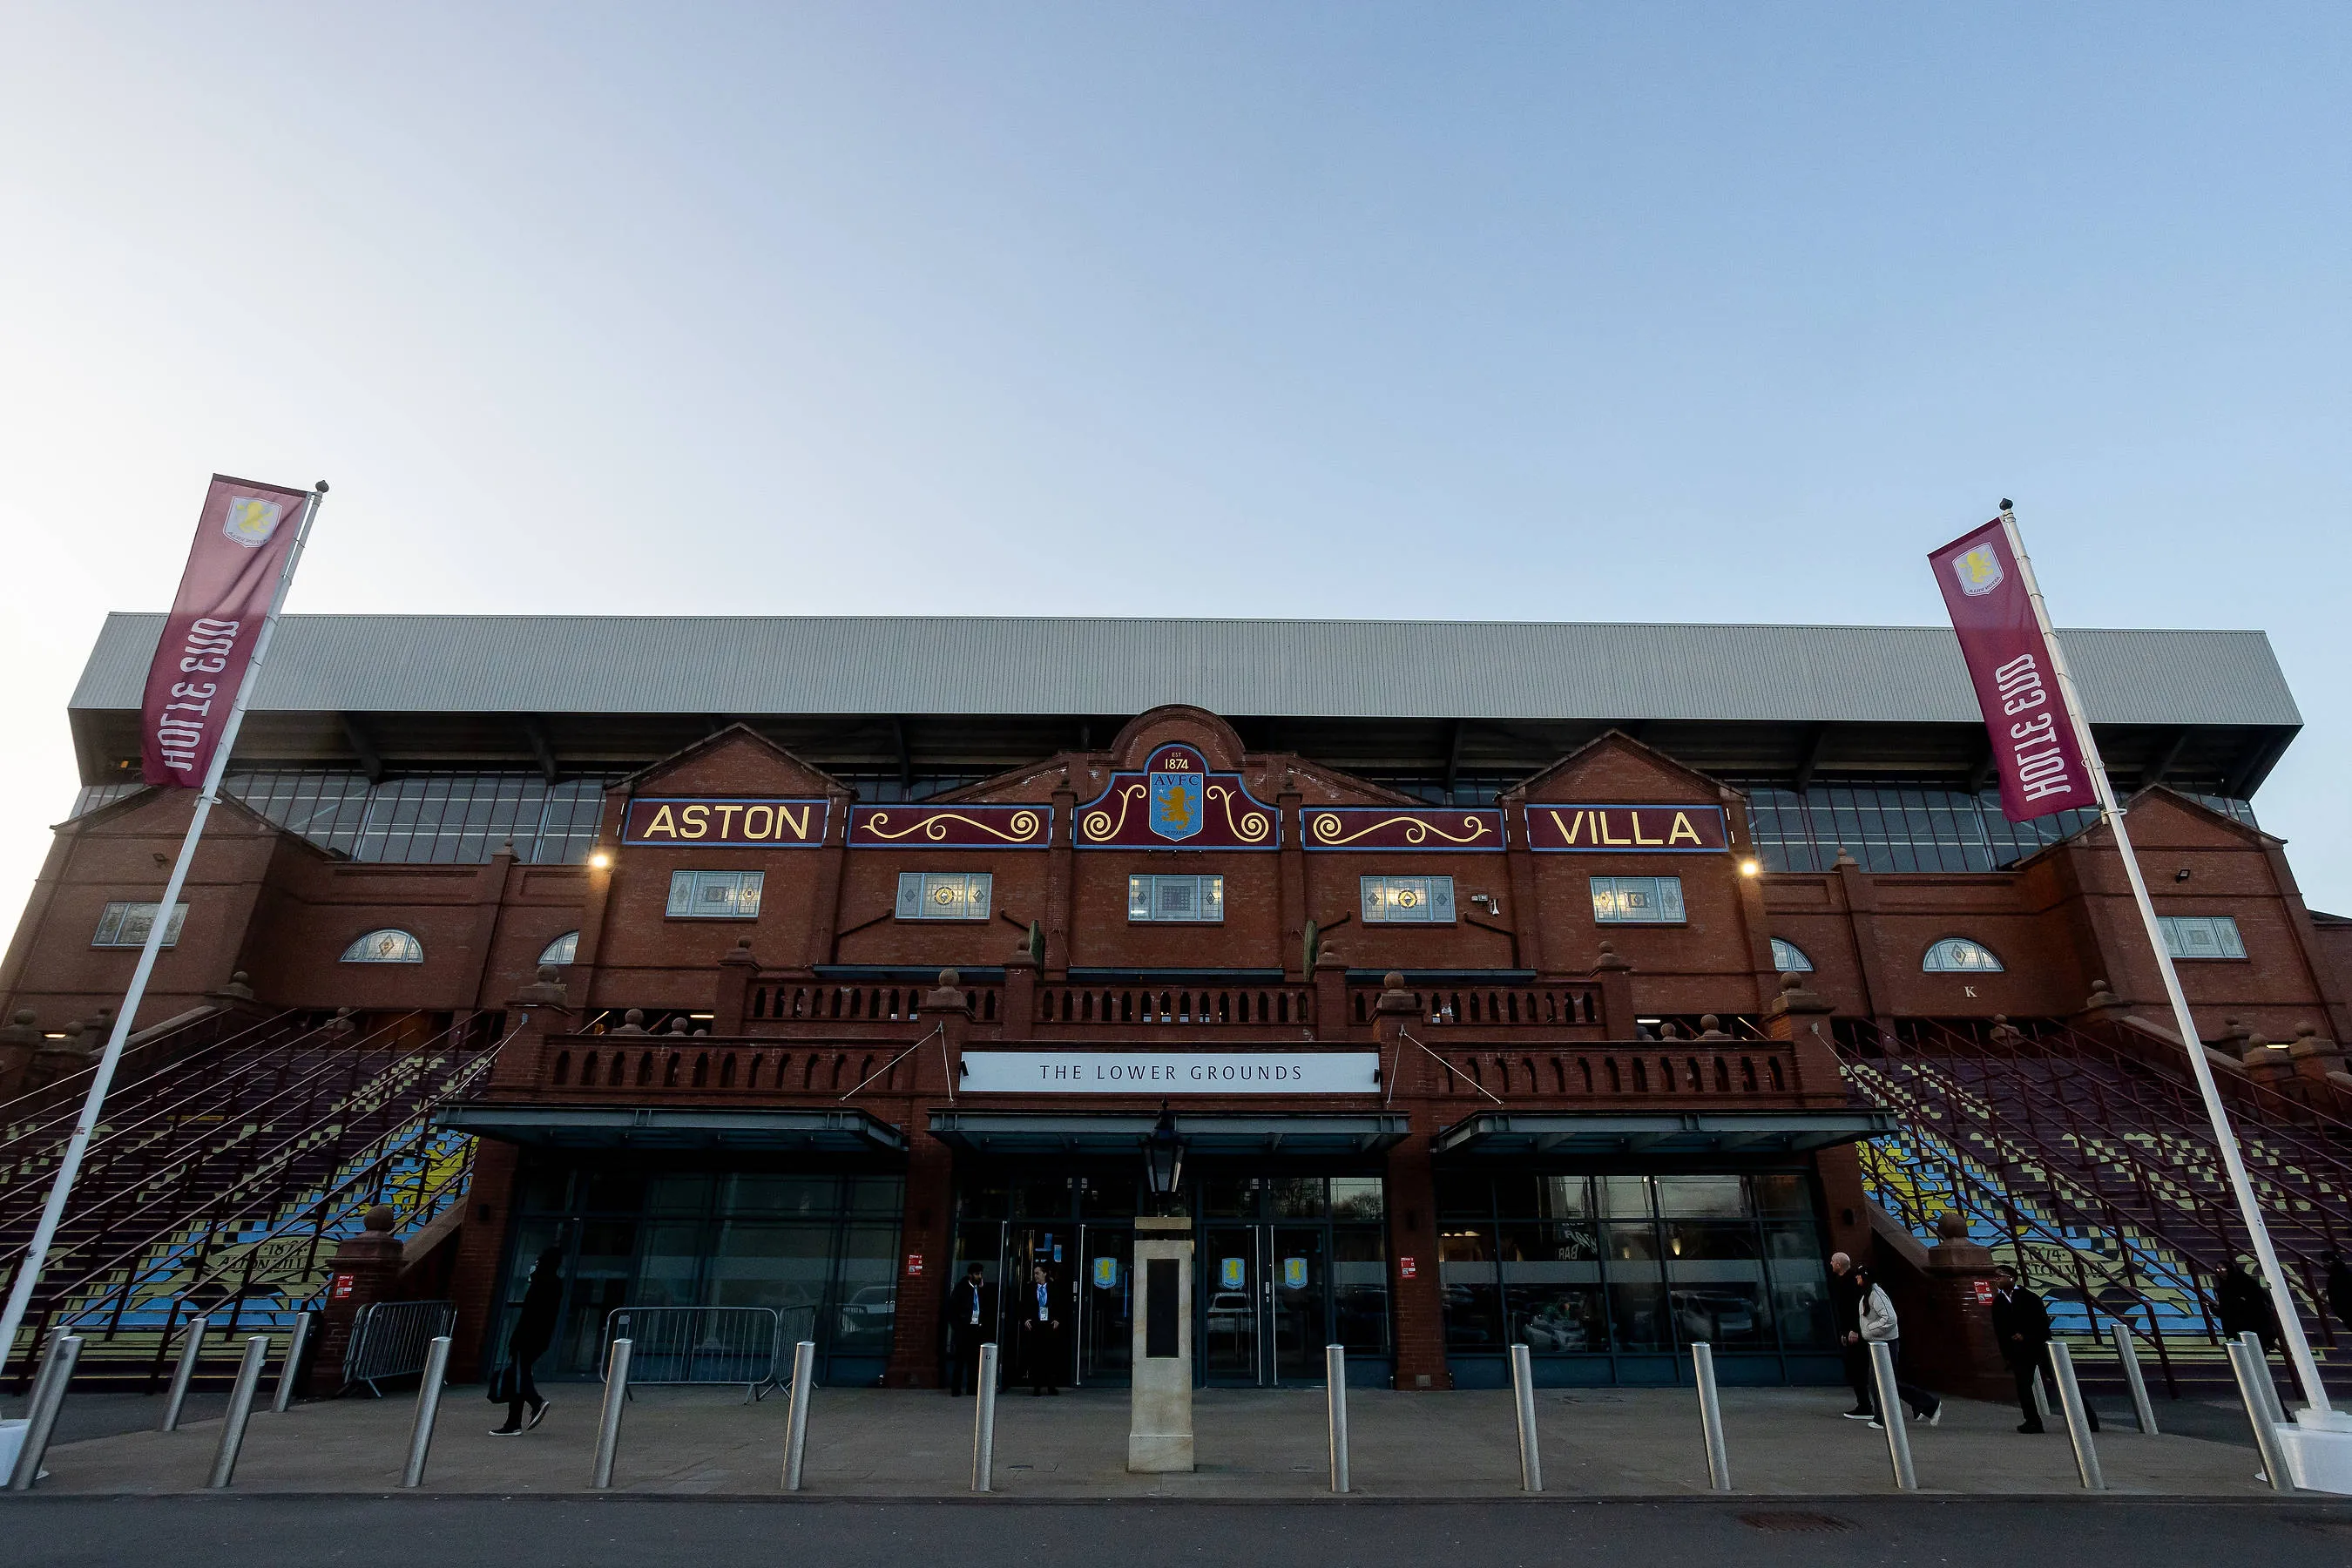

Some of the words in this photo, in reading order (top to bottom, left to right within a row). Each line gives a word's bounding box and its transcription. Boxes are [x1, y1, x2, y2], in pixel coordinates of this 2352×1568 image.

[1165, 758, 1189, 770] 1874
[1154, 774, 1200, 786] AVFC
[643, 804, 811, 841] ASTON
[1550, 810, 1703, 846] VILLA
[1964, 986, 1977, 998] K
[1039, 1065, 1082, 1080] THE
[1097, 1065, 1176, 1080] LOWER
[1190, 1065, 1302, 1080] GROUNDS
